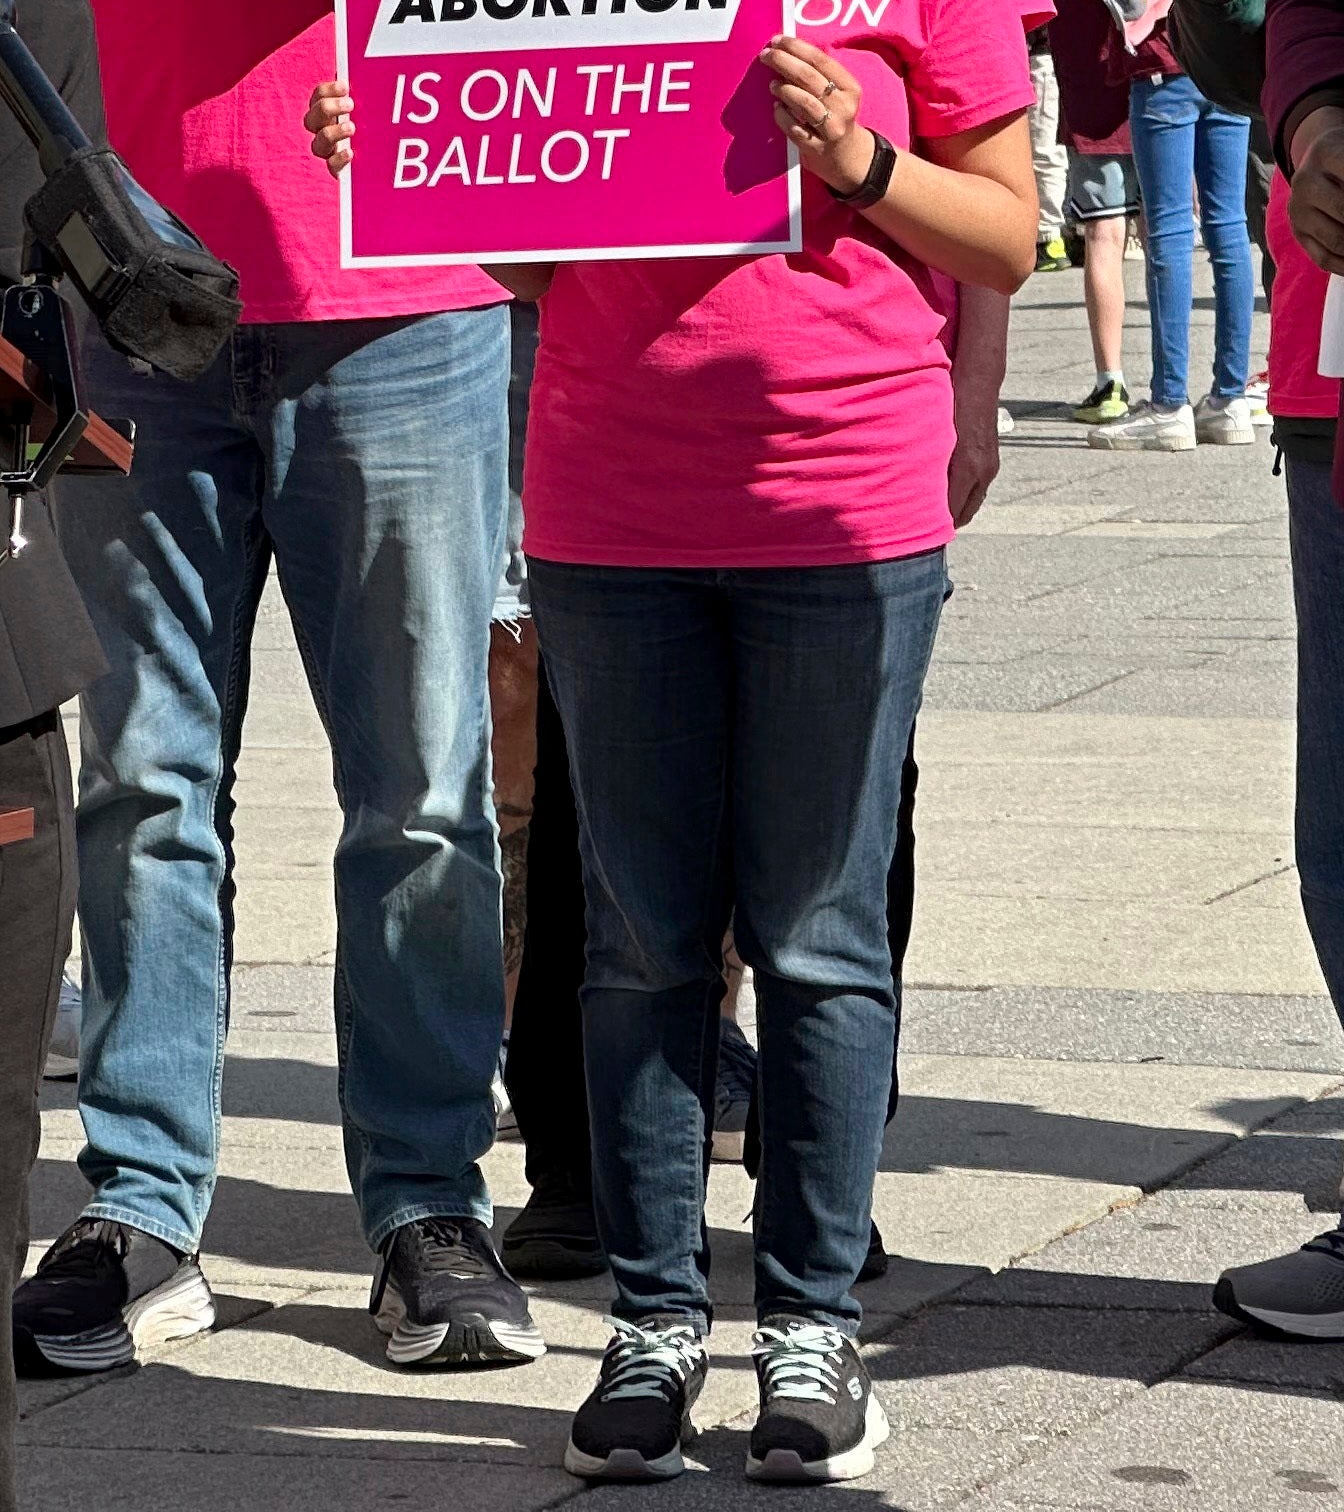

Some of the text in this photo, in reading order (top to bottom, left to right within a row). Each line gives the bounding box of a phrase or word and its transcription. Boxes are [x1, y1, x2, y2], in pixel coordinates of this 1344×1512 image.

[391, 61, 695, 124] IS ON THE
[392, 128, 630, 189] BALLOT
